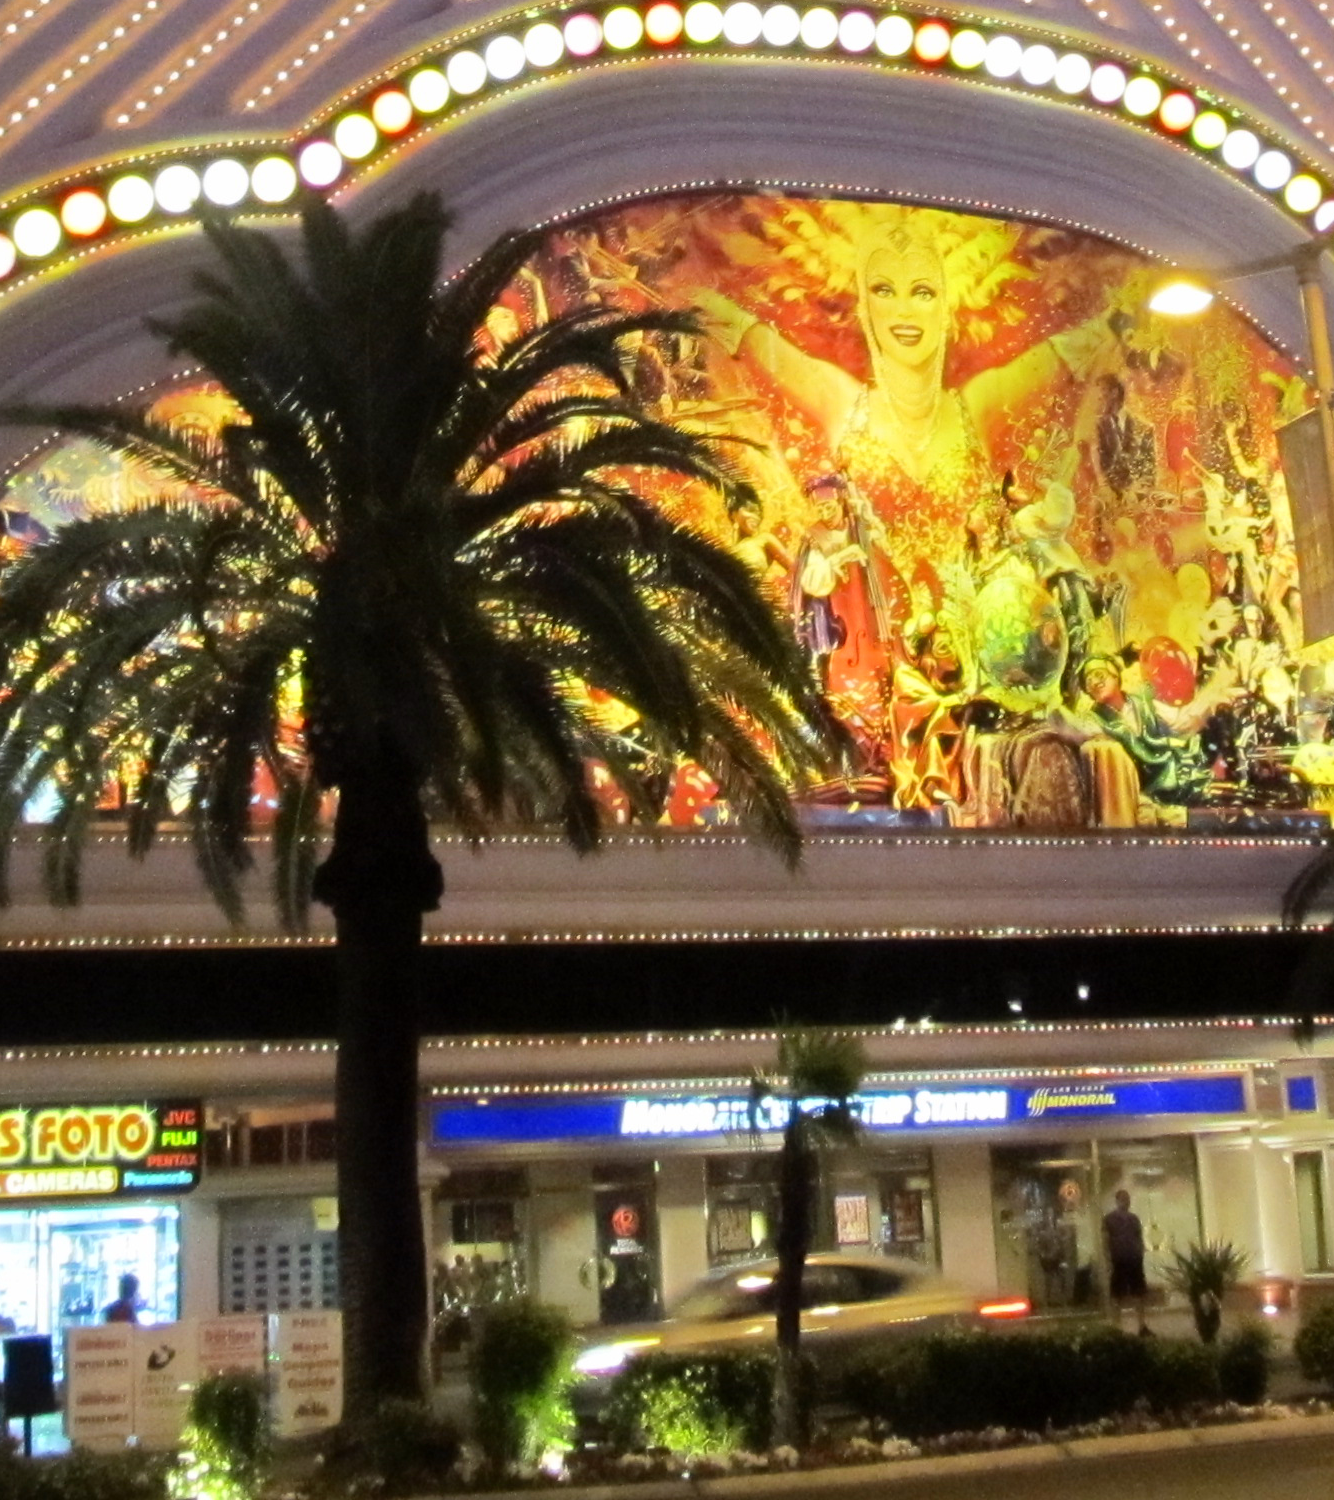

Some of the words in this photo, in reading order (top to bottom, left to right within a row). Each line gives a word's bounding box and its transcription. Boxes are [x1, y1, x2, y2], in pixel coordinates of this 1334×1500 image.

[914, 1090, 1007, 1124] STATION
[1046, 1092, 1116, 1107] MONORAIL
[163, 1111, 196, 1126] JVC
[31, 1107, 155, 1163] FOTO
[161, 1130, 198, 1147] FUJI
[146, 1153, 198, 1168] PENTAX
[5, 1169, 115, 1195] CAMERAS
